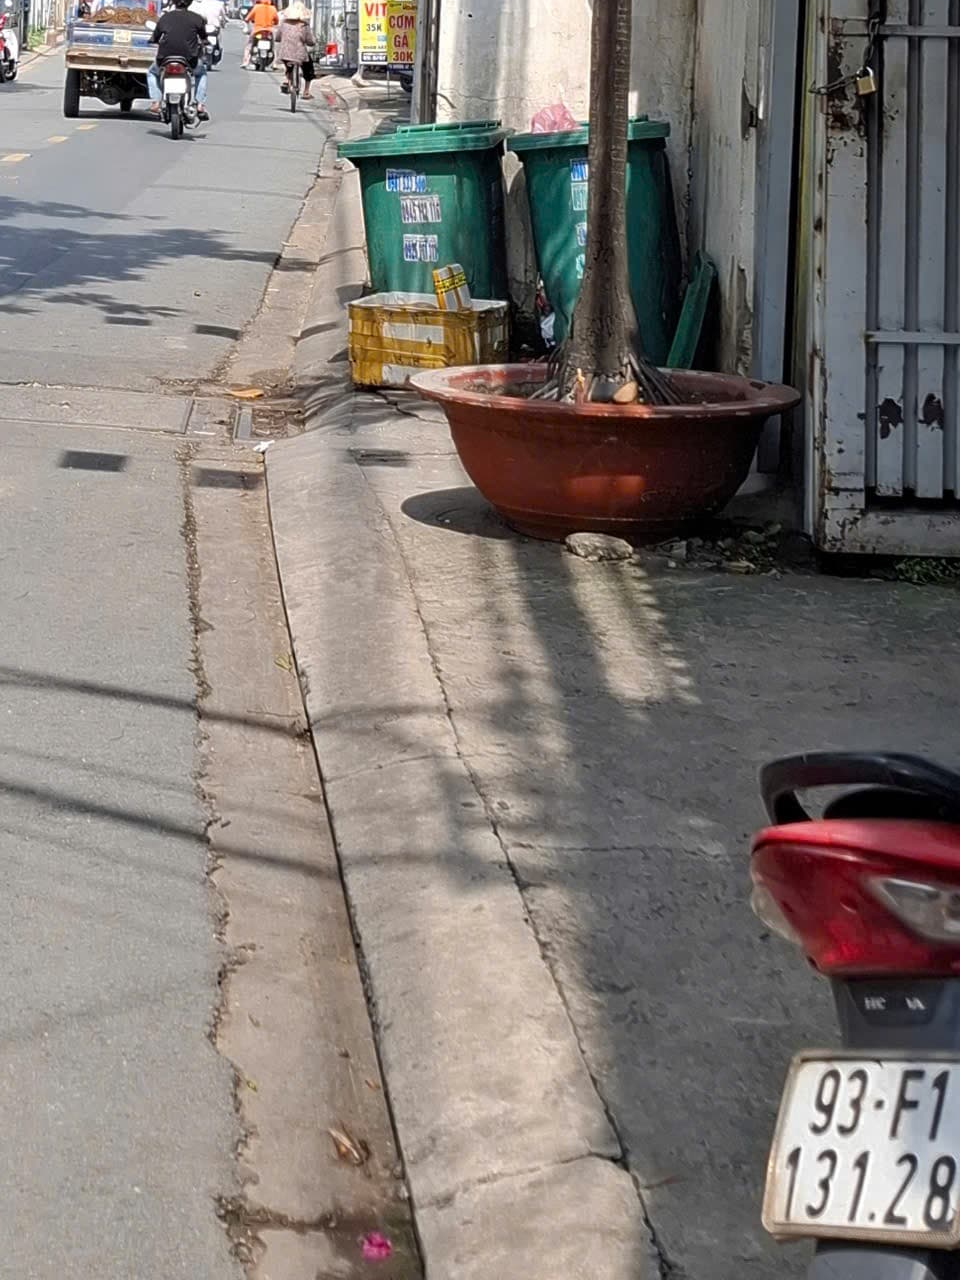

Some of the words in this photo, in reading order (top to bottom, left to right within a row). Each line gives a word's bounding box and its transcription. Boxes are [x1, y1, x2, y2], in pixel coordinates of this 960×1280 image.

[389, 15, 415, 29] CƠM
[393, 32, 409, 47] GÀ
[392, 52, 413, 62] 30K
[785, 1147, 957, 1232] 131.28
